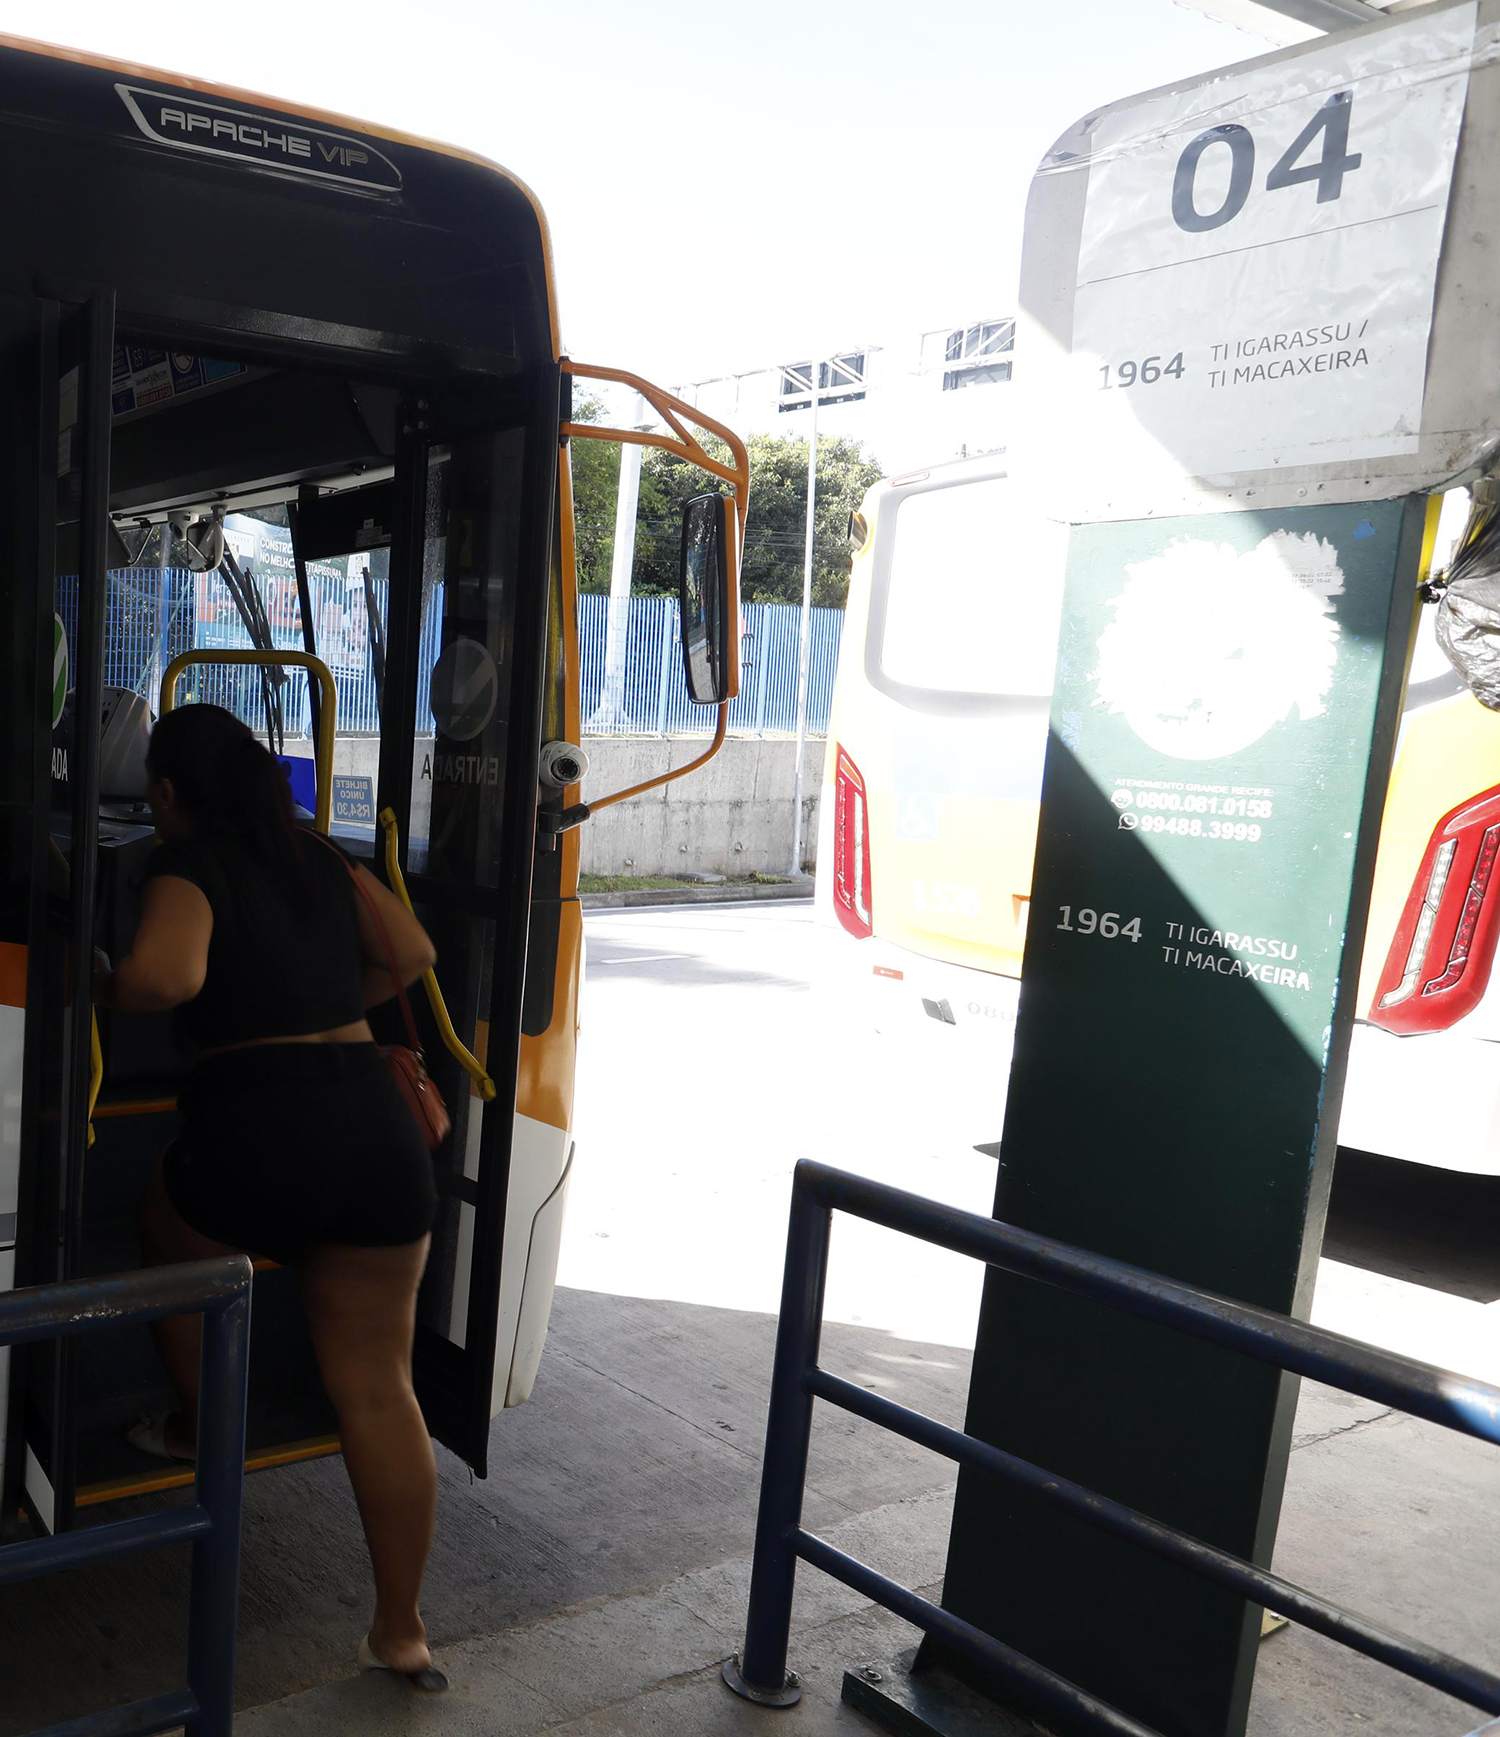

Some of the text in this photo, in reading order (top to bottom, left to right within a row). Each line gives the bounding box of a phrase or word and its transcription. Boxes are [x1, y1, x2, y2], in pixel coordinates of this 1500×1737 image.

[160, 106, 369, 167] APACHE VIP
[1171, 89, 1362, 233] 04
[1209, 343, 1229, 362] TI
[1235, 321, 1352, 358] IGARASSU
[1098, 351, 1186, 391] 1964
[1207, 347, 1369, 389] TI MACAXEIRA
[270, 554, 296, 569] MELHO
[1114, 779, 1274, 797] ATENDIMENTO GRANDE RECIFE:
[1136, 791, 1273, 819] 0800.081.0158
[1140, 814, 1262, 842] 99488.3999
[1056, 905, 1143, 943] 1964
[1165, 921, 1298, 961] TI IGARASSU
[1161, 946, 1310, 991] TI MACAXEIRA
